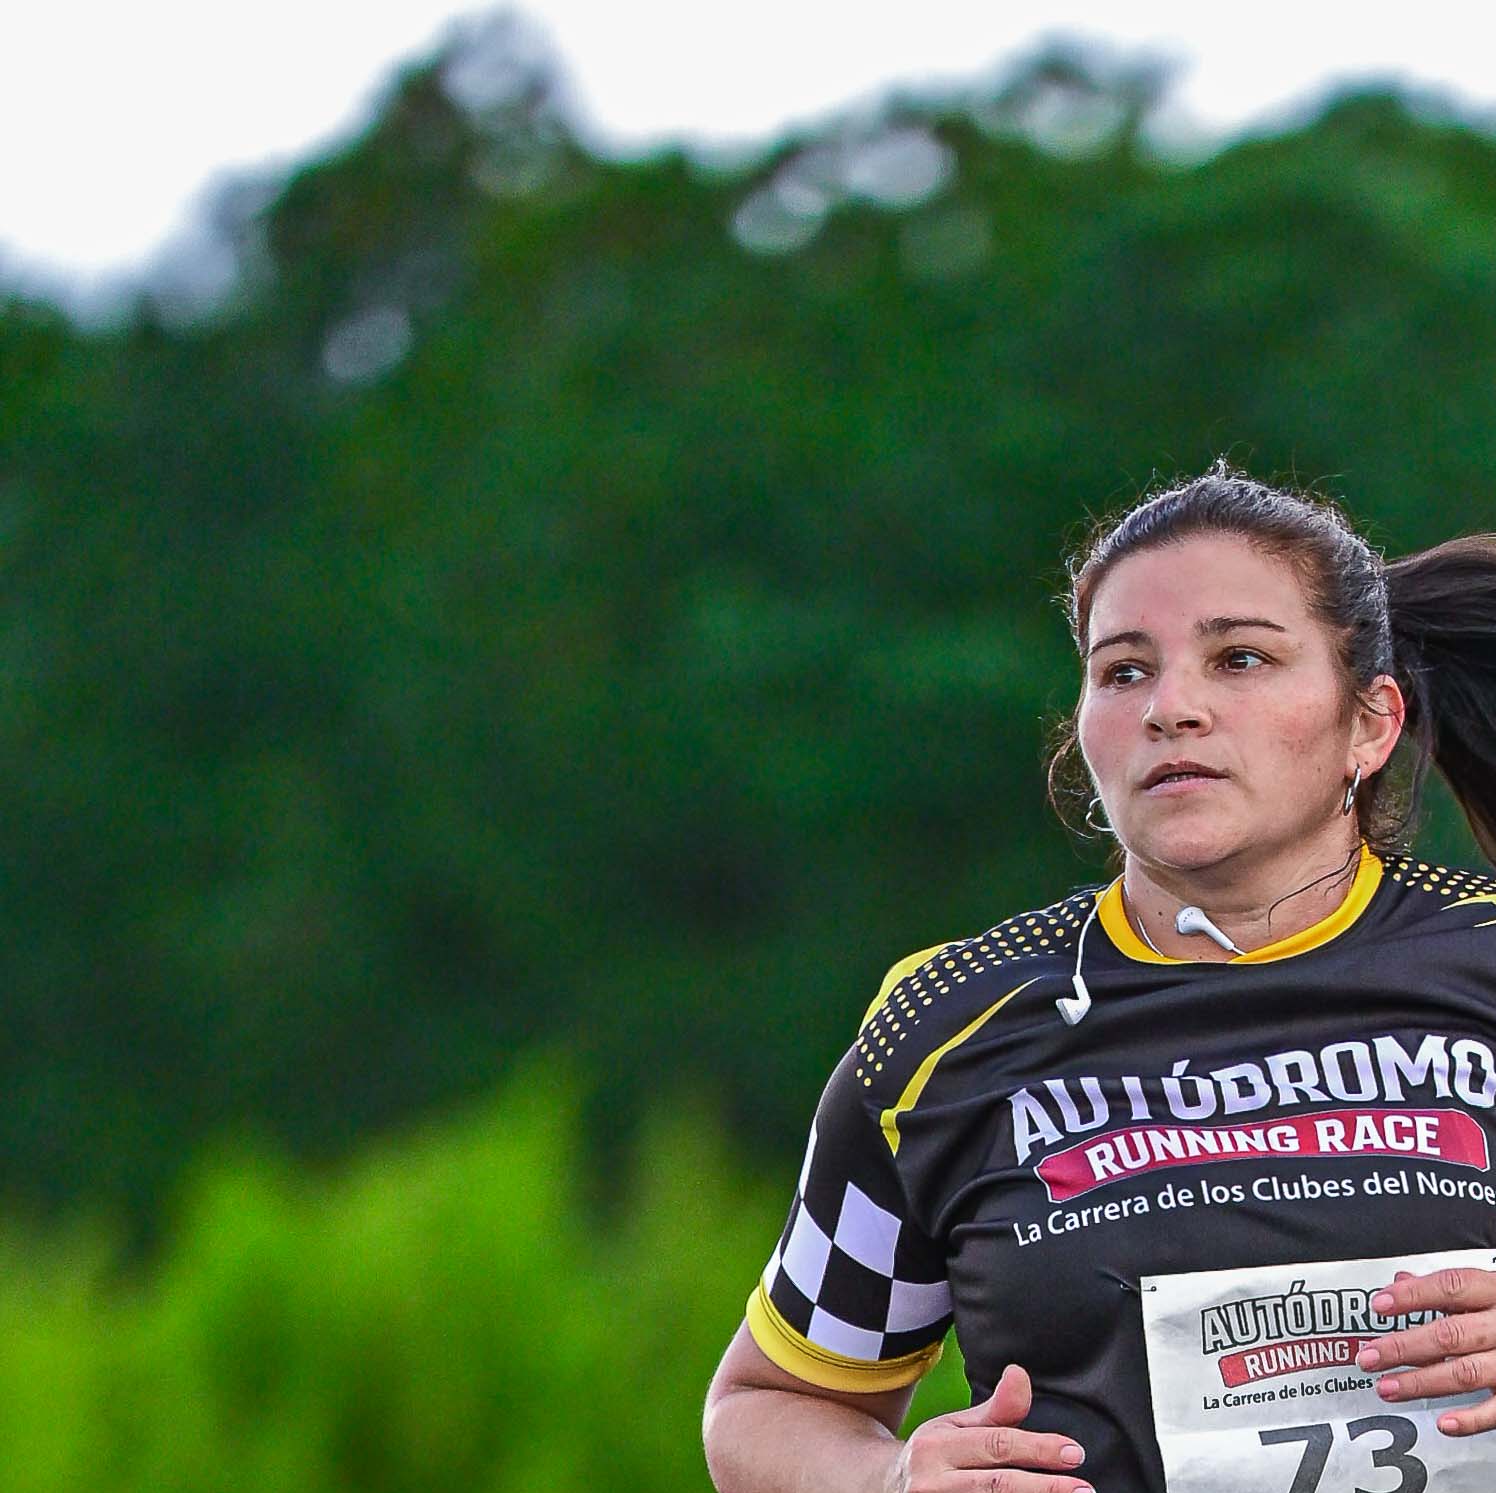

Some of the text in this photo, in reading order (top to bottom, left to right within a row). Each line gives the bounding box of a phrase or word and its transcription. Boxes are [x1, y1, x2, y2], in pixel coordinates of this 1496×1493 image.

[1084, 1114, 1441, 1182] RUNNING RACE
[1013, 1222, 1042, 1247] La
[1047, 1195, 1150, 1235] Carrera
[1157, 1183, 1195, 1209] de
[1201, 1180, 1245, 1204] los
[1252, 1174, 1355, 1201] Clubes
[1363, 1170, 1410, 1196] del
[1243, 1340, 1350, 1379] RUNNING
[1203, 1377, 1373, 1410] La Carrera de los Clubes
